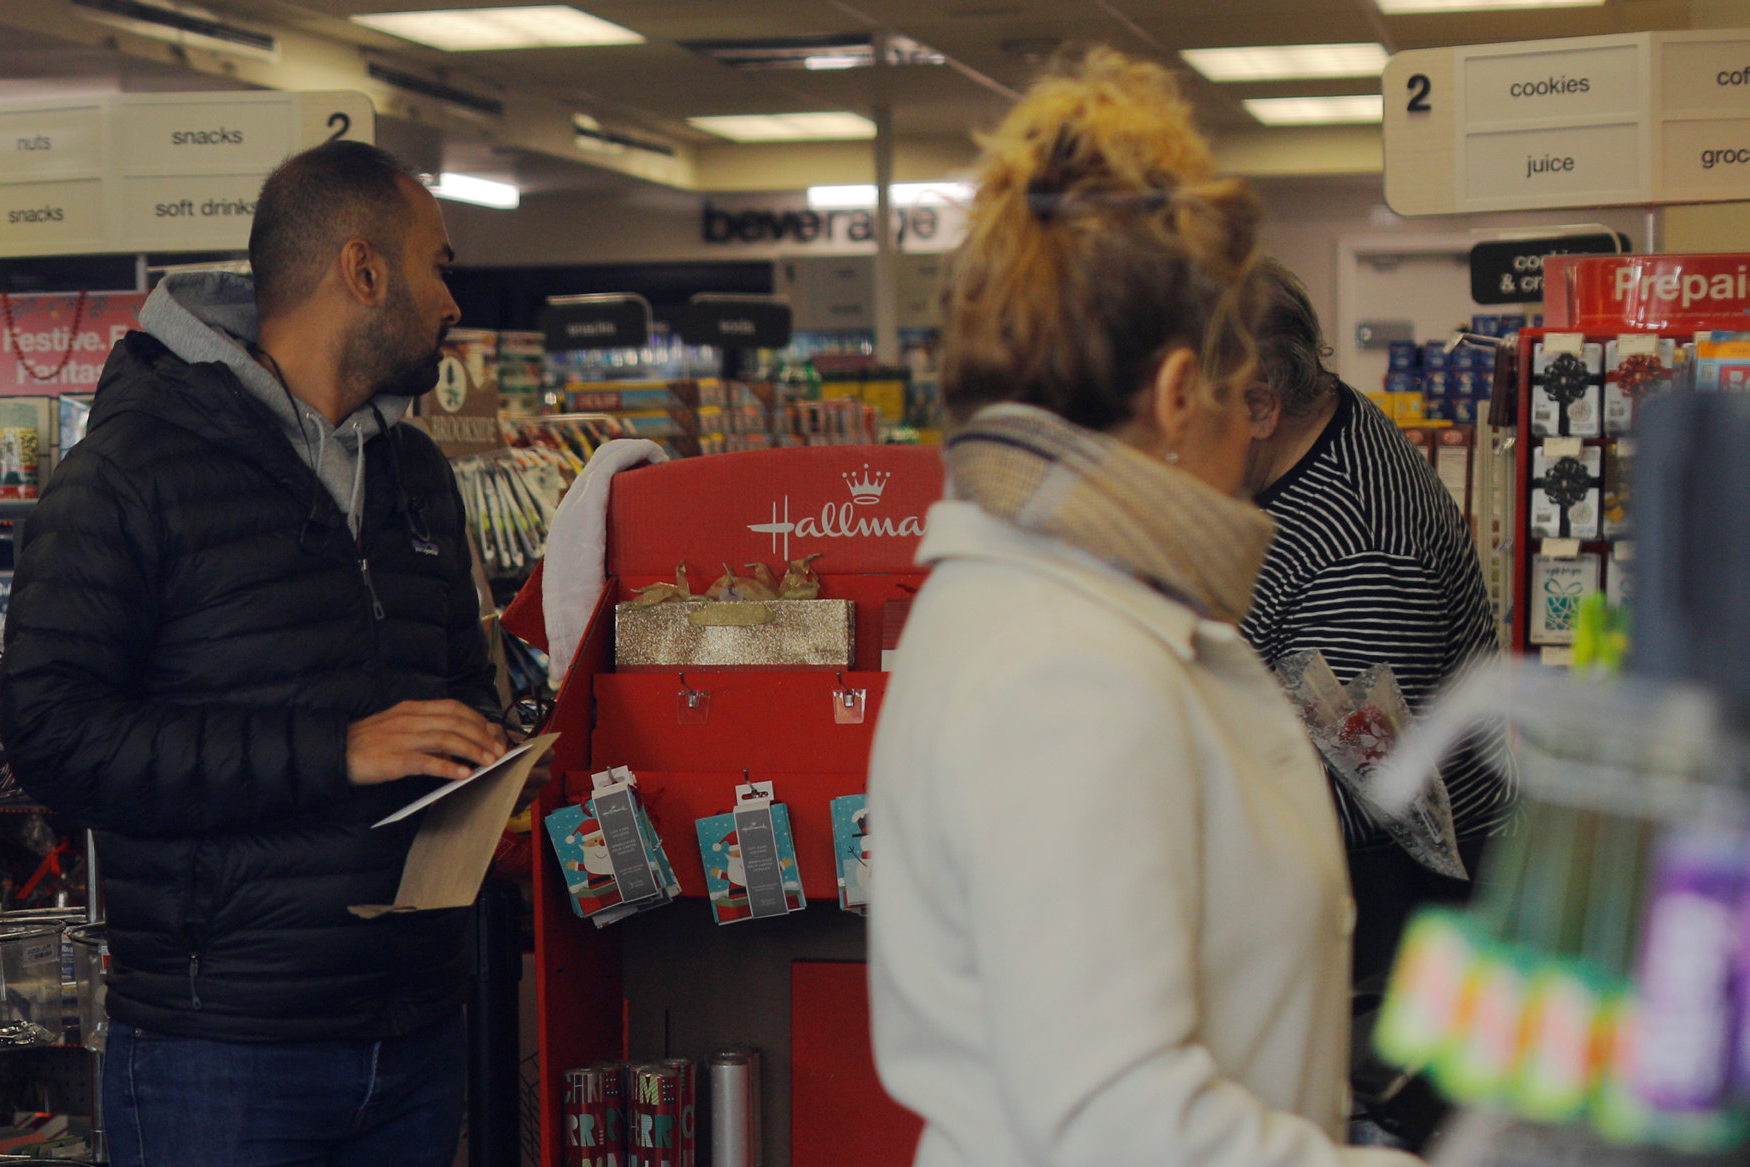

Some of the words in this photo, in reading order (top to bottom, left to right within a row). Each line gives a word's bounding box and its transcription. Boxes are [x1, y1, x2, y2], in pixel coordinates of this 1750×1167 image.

[1406, 74, 1432, 112] 2
[1510, 76, 1590, 97] cookies
[17, 135, 51, 151] nuts
[172, 128, 244, 145] snacks
[1526, 154, 1575, 178] juice
[8, 204, 65, 223] snacks
[156, 199, 193, 217] soft
[1500, 273, 1516, 293] &
[1616, 265, 1750, 309] Prepai
[746, 494, 930, 562] Hallma
